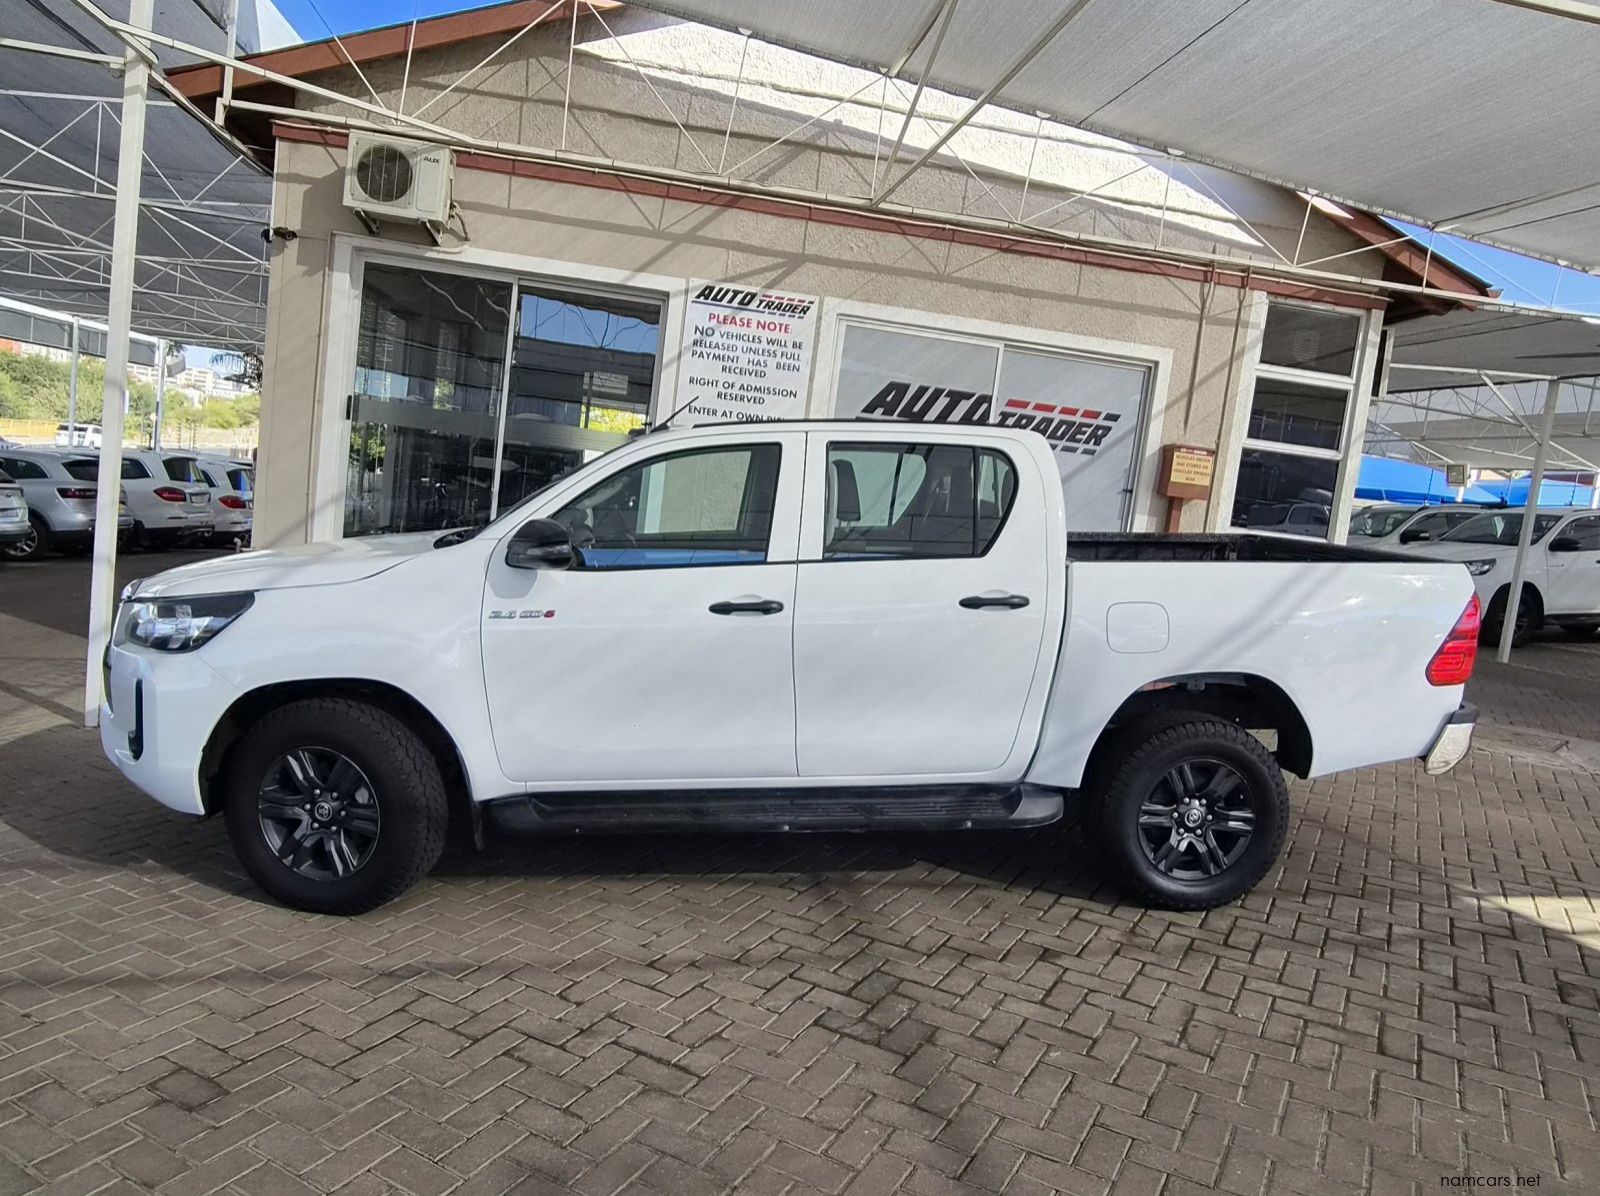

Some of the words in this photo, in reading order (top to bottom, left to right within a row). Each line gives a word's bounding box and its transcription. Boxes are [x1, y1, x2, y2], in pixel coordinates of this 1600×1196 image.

[694, 285, 758, 306] AUTO
[756, 299, 811, 315] TRADER
[708, 312, 752, 328] PLEASE
[694, 325, 715, 337] NO
[719, 330, 762, 344] VEHICLES
[766, 337, 788, 348] WILL
[792, 341, 803, 350] BE
[692, 338, 738, 352] RELEASED
[741, 345, 777, 358] UNLESS
[780, 350, 801, 361] FULL
[691, 350, 740, 364] PAYMENT
[747, 357, 768, 368] HAS
[775, 361, 801, 372] BEEN
[688, 376, 719, 388] RIGHT
[722, 381, 736, 390] OF
[738, 383, 797, 398] ADMISSION
[688, 405, 718, 417] ENTER
[720, 410, 733, 419] AT
[736, 411, 764, 421] OWN
[860, 380, 994, 424] AUTO
[997, 410, 1113, 446] TRADER
